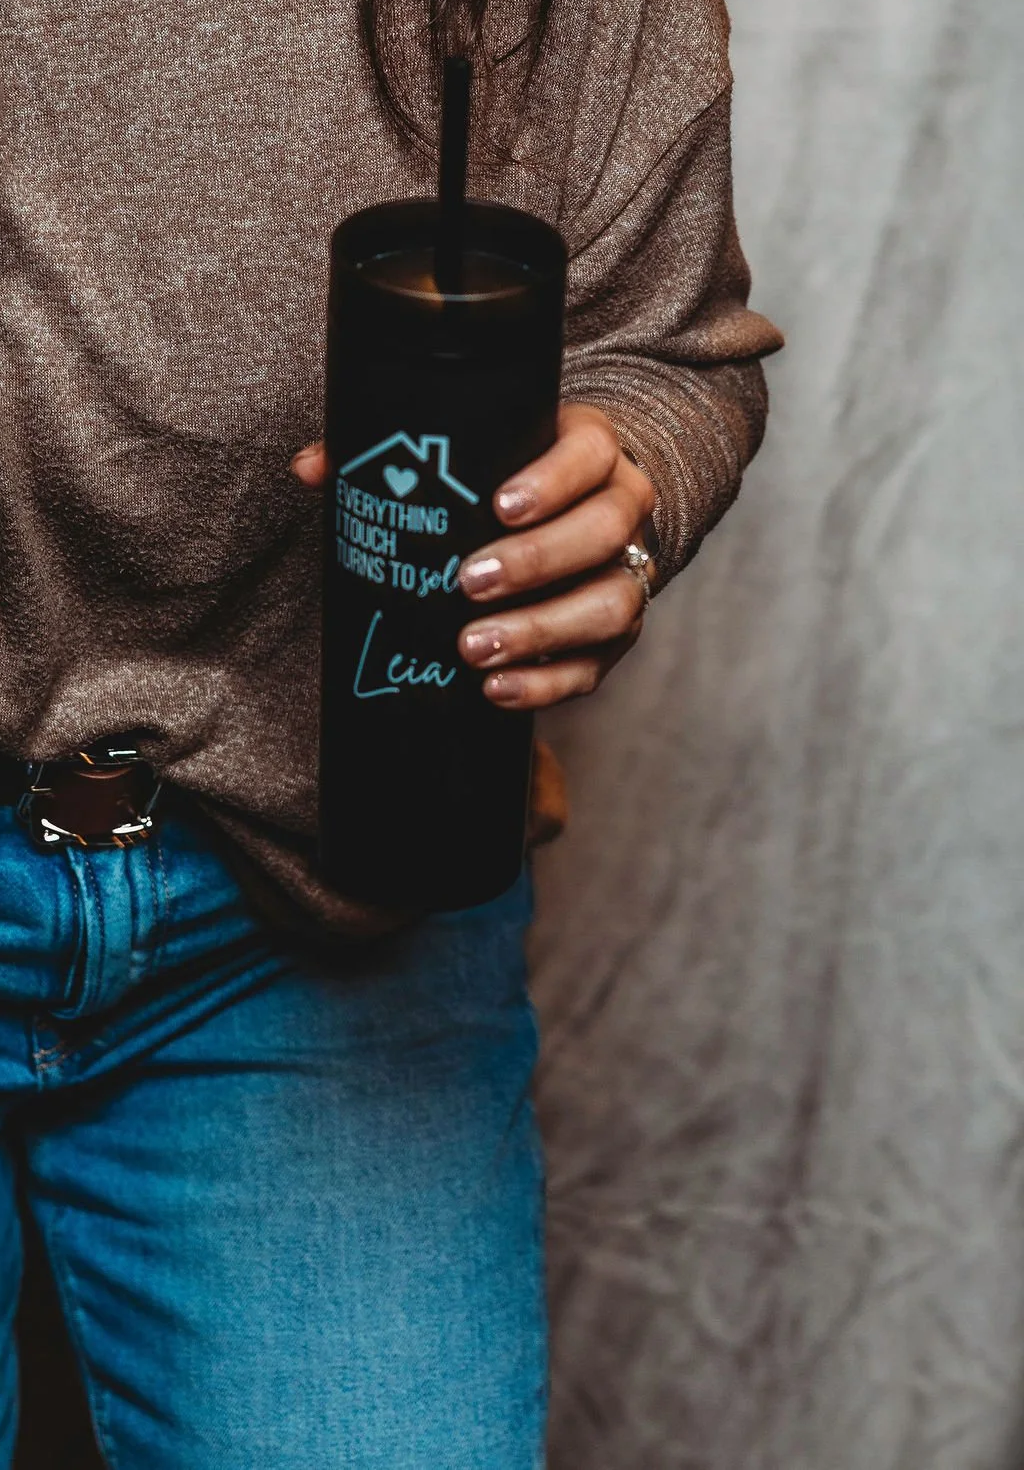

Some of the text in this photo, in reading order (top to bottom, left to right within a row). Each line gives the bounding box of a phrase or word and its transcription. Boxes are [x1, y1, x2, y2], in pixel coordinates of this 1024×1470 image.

[336, 477, 448, 535] EVERYTHING
[343, 511, 397, 557] TOUCH
[336, 535, 460, 598] TURNS TO sol
[353, 609, 457, 698] Leia
